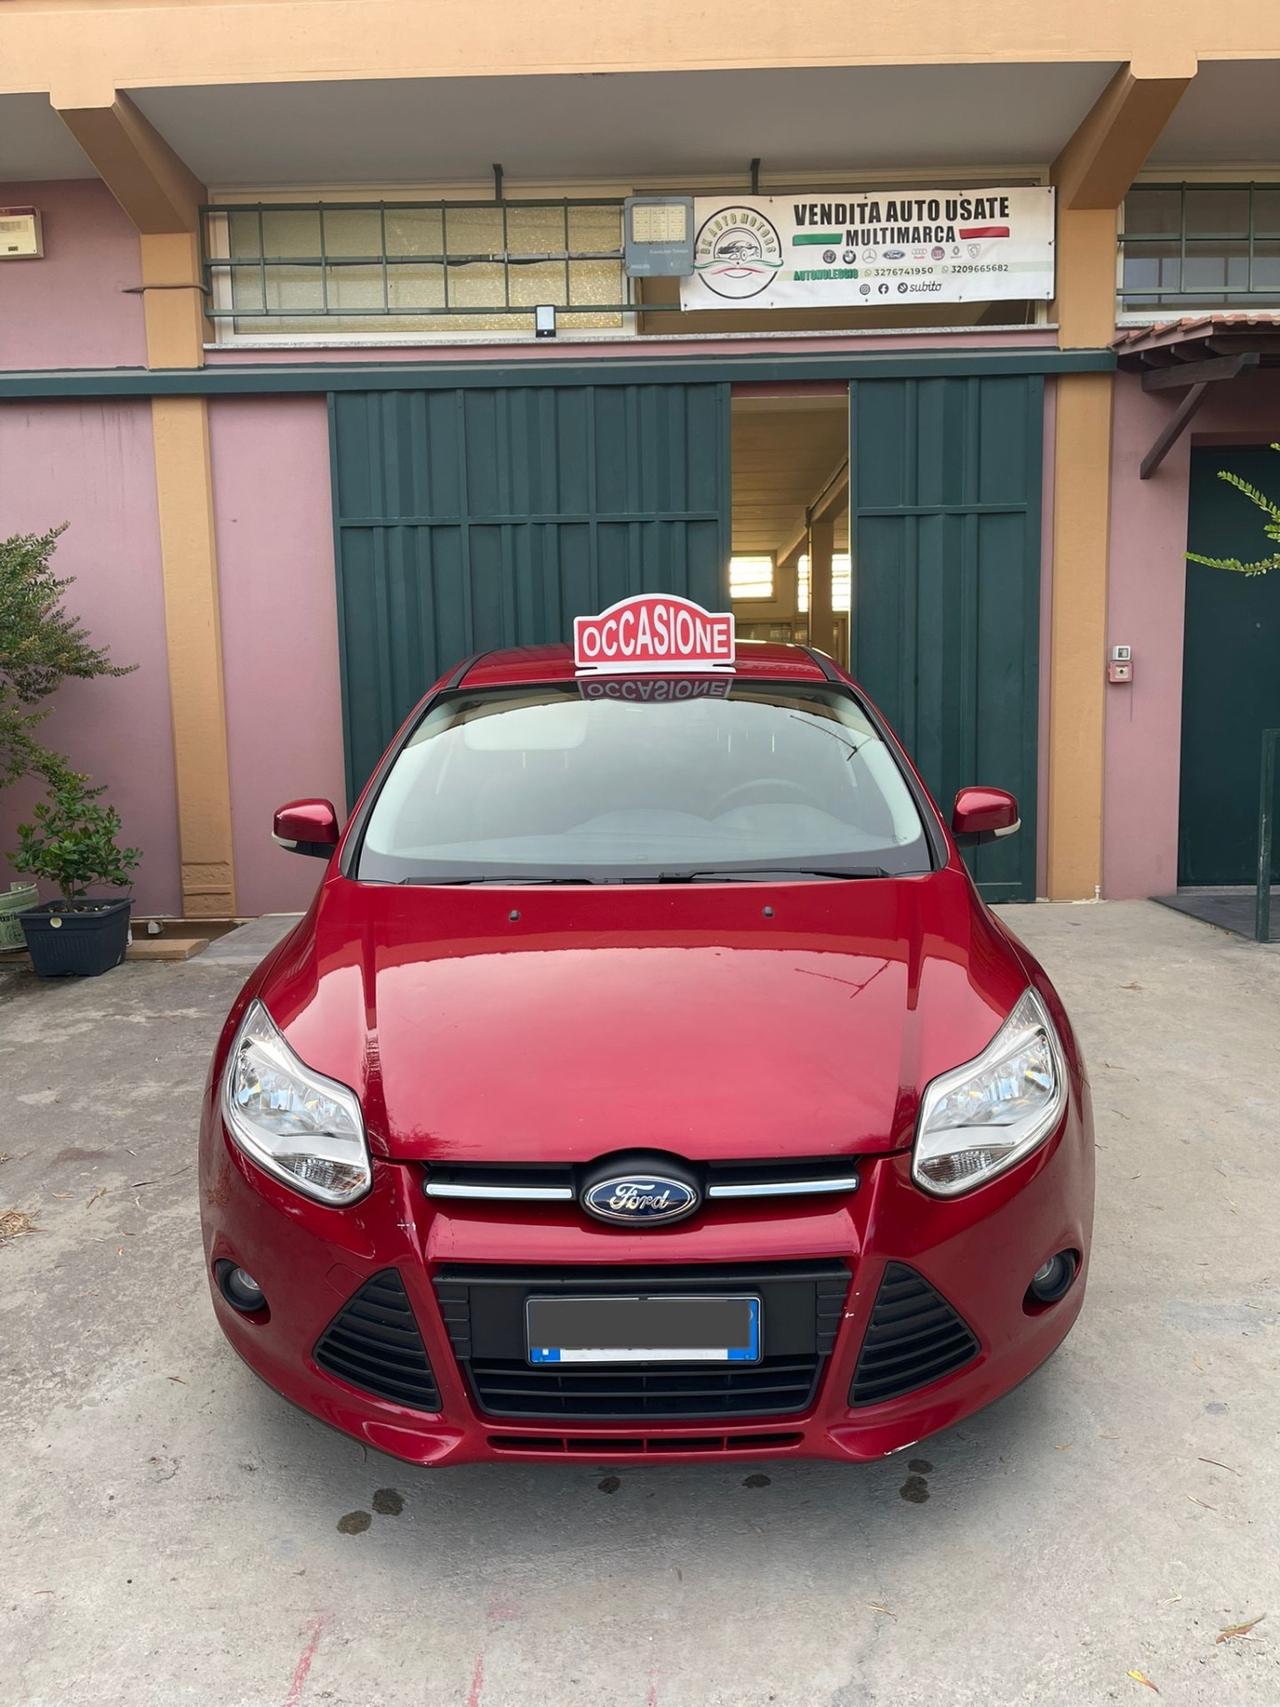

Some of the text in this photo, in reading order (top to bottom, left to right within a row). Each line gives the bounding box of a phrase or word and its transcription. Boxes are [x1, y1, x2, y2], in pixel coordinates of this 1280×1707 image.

[793, 196, 1010, 225] VENDITA AUTO USATE
[845, 225, 956, 247] MULTIMARCA
[873, 266, 934, 277] 3276741950
[951, 264, 1009, 274] 3209665682
[909, 282, 942, 293] subito
[582, 604, 729, 657] OCCASIONE
[609, 1183, 670, 1210] Ford
